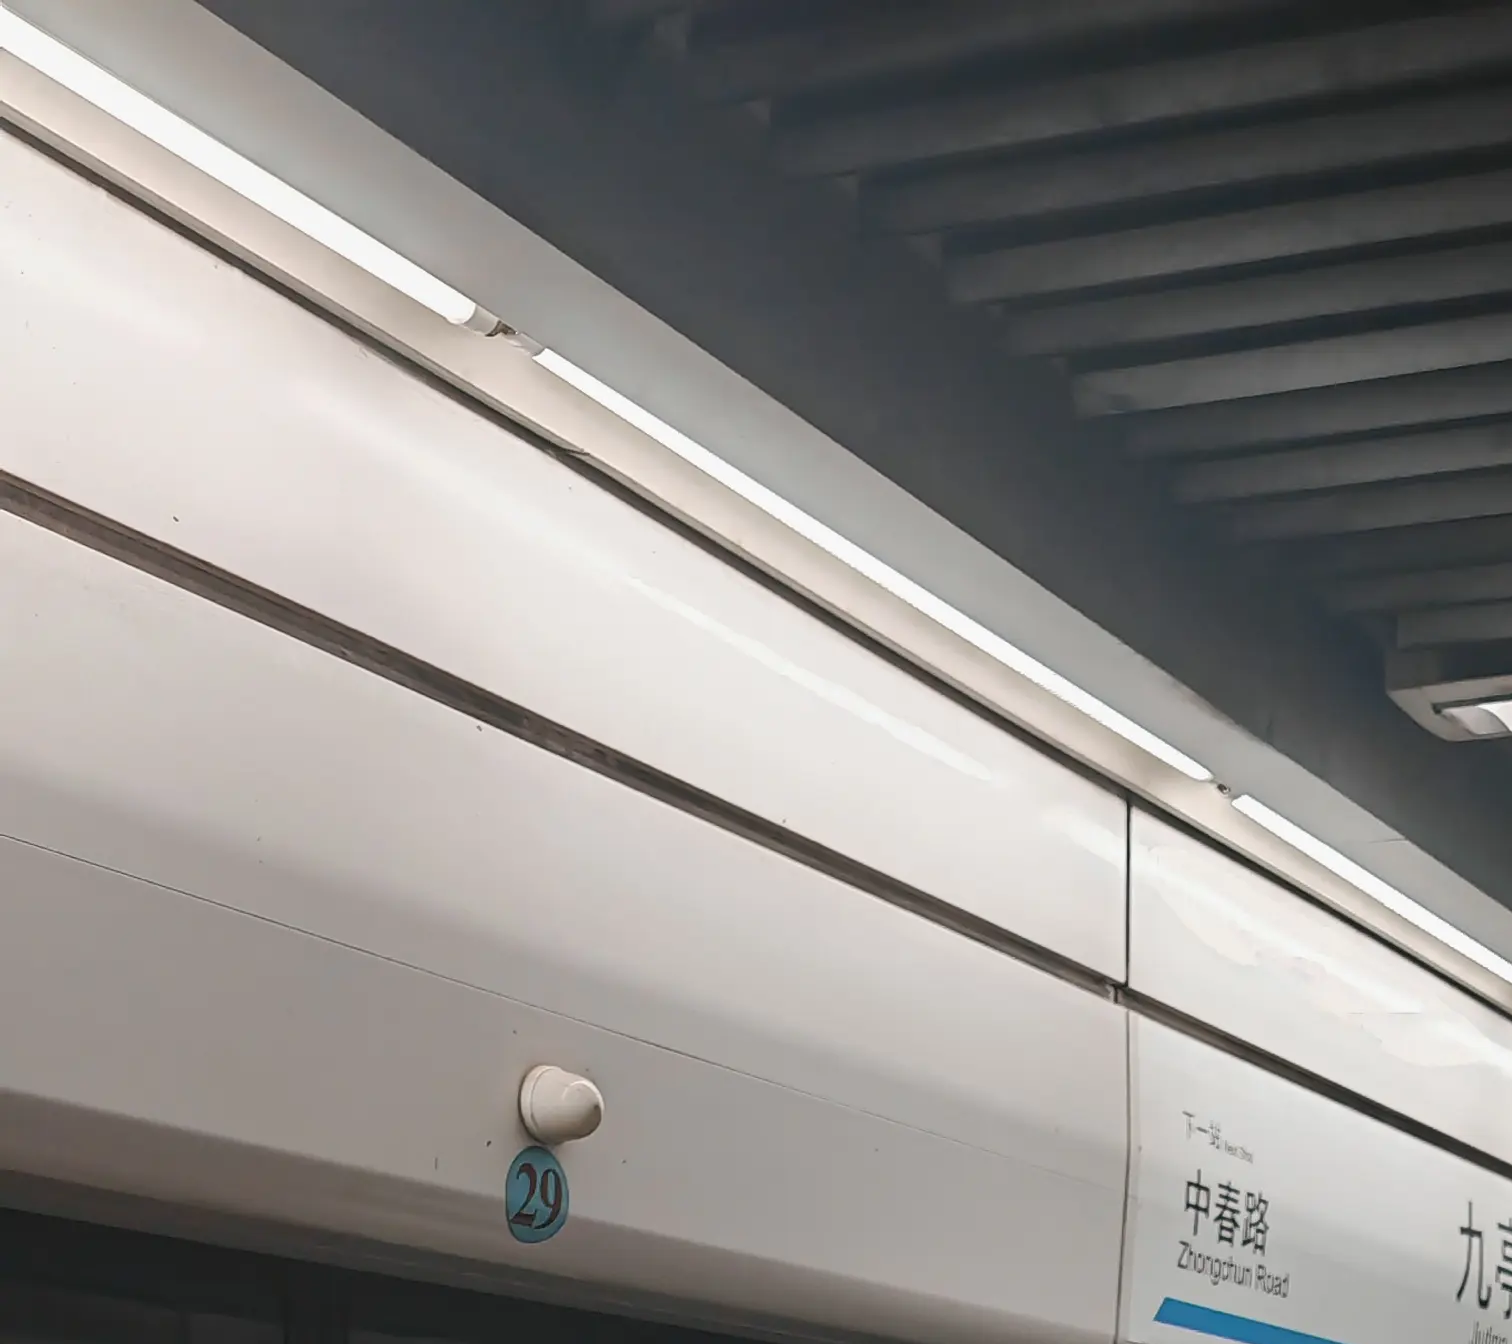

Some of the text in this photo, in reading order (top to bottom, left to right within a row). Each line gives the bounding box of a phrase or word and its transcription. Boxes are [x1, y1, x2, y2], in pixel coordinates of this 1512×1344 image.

[509, 1162, 563, 1230] 29
[1183, 1168, 1270, 1257] 中春路
[1177, 1240, 1290, 1299] Zhongchun Road
